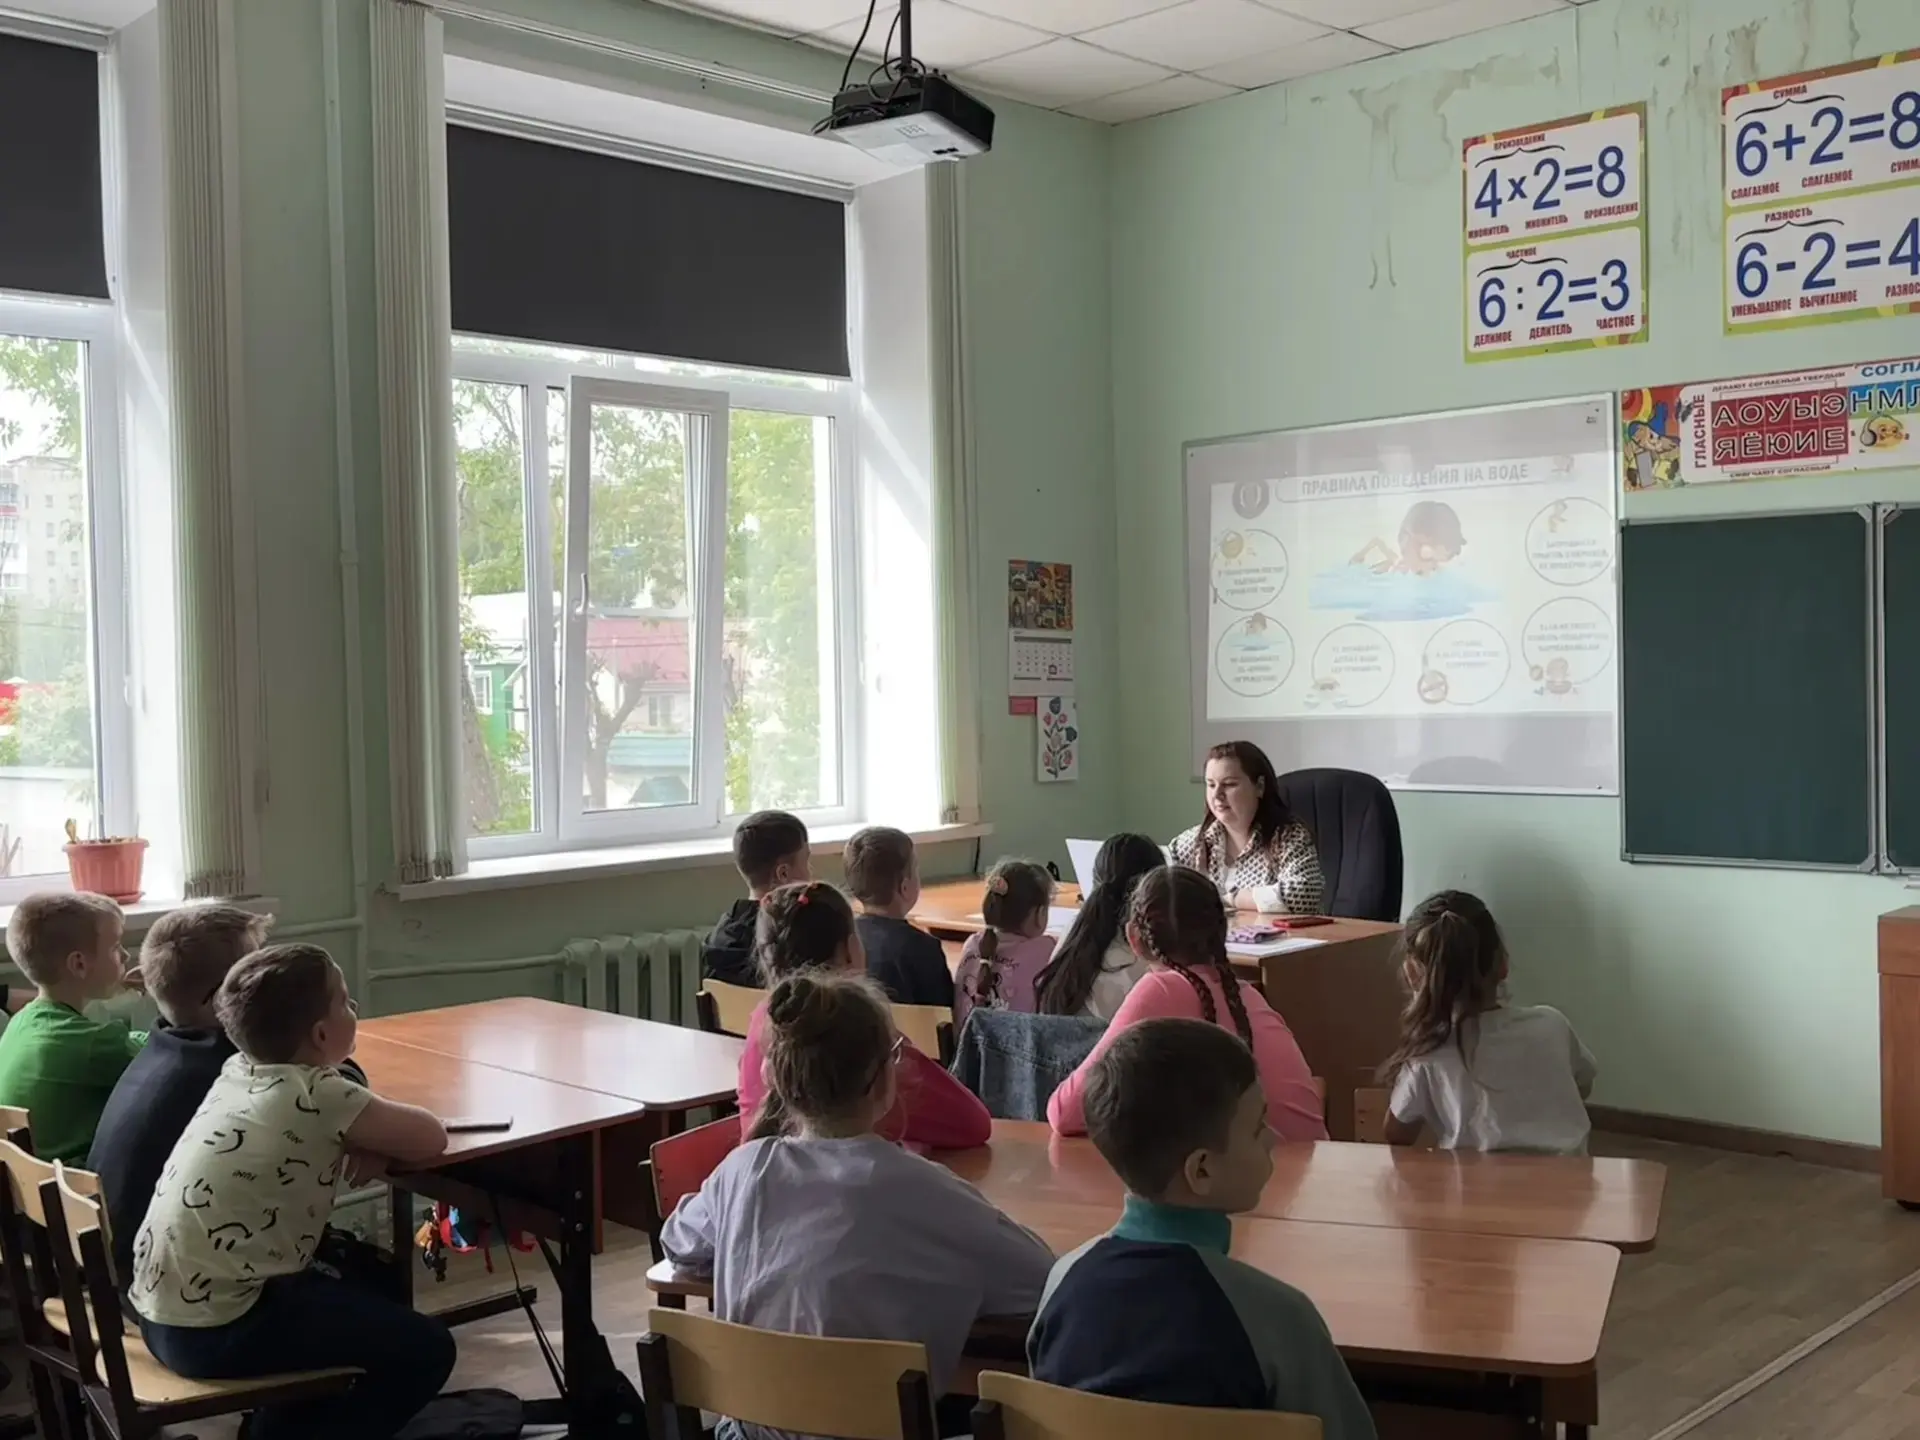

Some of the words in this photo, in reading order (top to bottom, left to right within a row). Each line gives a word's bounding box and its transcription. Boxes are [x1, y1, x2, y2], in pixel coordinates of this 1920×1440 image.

[1773, 85, 1808, 100] СУММА
[1731, 182, 1780, 200] СЛАГАЕМОЕ
[1801, 169, 1853, 188] СЛАГАЕМОЕ
[1890, 158, 1920, 173] СУММ
[1765, 207, 1813, 222] РАЗНОСТЬ
[1506, 246, 1537, 259] ЧАСТНОЕ
[1731, 299, 1791, 317] УМЕНЬШАЕМОЕ
[1800, 290, 1857, 308] ВЫЧИТАЕМОЕ
[1474, 330, 1512, 347] ДЕЛИМОЕ
[1529, 323, 1572, 340] ДЕЛИТЕЛЬ
[1596, 314, 1635, 329] ЧАСТНОЕ
[1692, 393, 1706, 468] ГЛАСНЫЕ
[1302, 475, 1367, 496] ПРАВИЛА
[1464, 466, 1484, 483] НА
[1488, 463, 1529, 482] ВОДЕ
